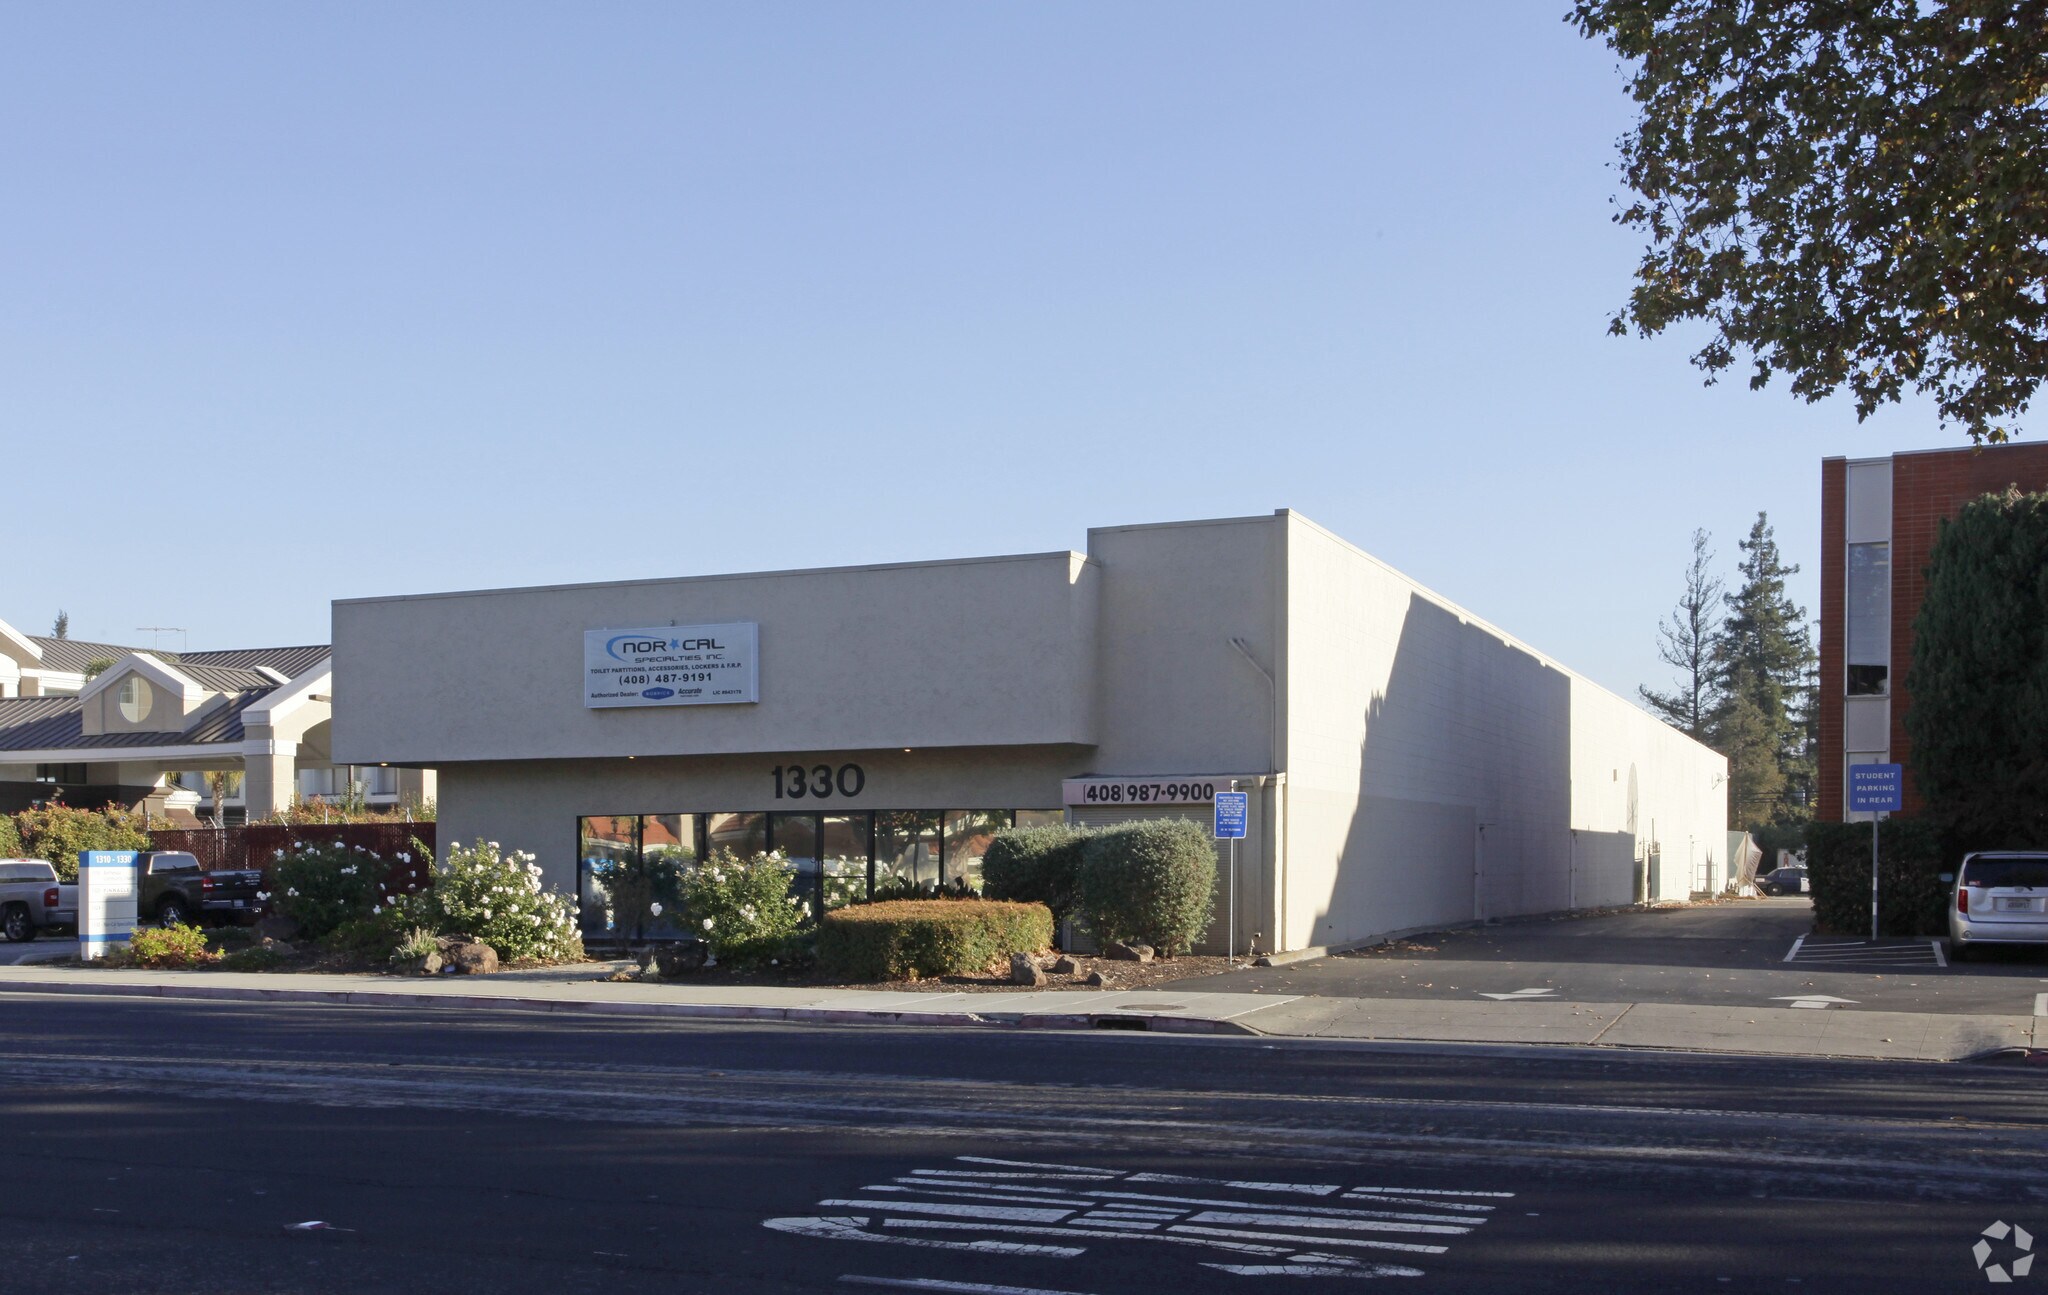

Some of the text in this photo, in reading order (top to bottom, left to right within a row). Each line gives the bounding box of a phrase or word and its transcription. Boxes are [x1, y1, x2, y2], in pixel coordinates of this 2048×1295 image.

[623, 638, 725, 653] NOR CAL
[648, 664, 690, 672] ACCESSORIES,
[619, 672, 712, 686] (408) 487-9191
[678, 687, 702, 695] Accurate
[771, 763, 865, 799] 1330
[1083, 784, 1124, 803] (408)
[95, 855, 111, 864] 1310
[117, 855, 132, 864] 1330
